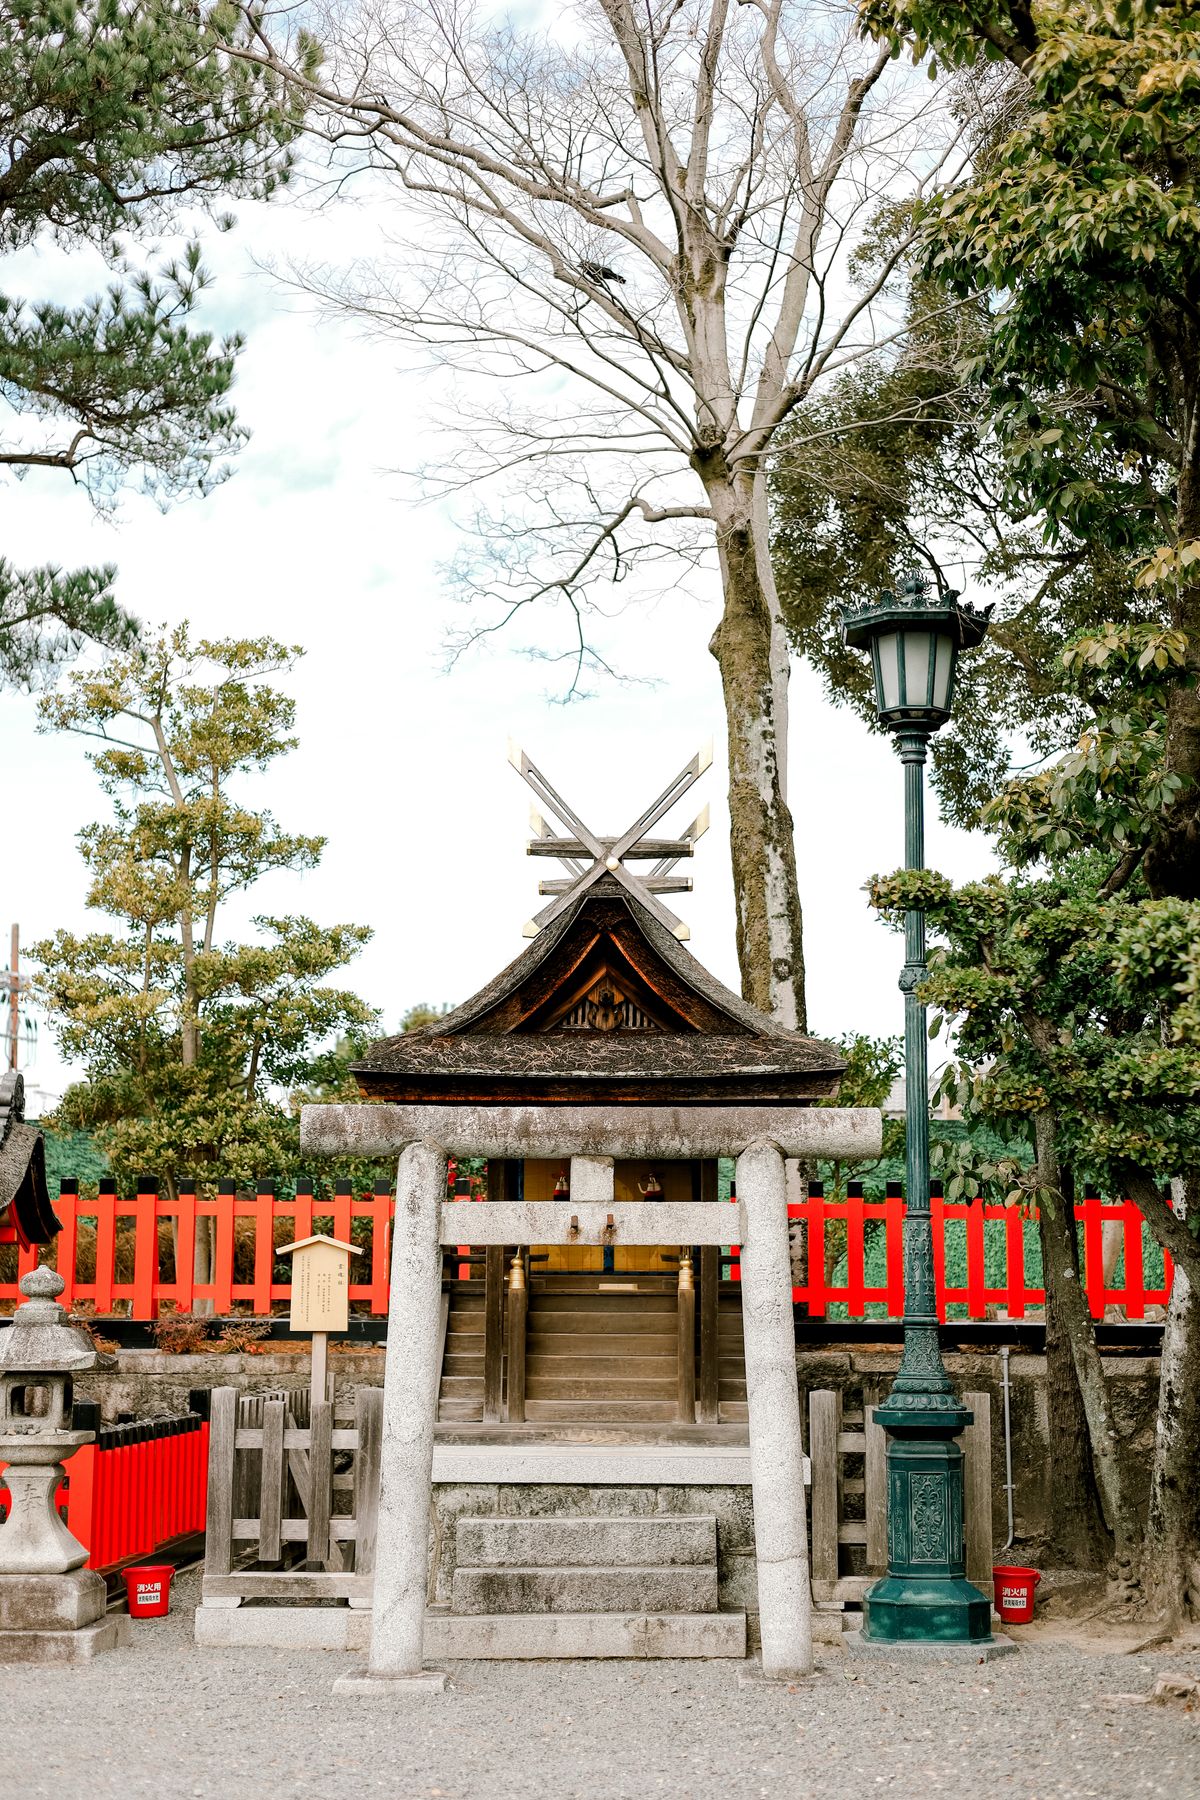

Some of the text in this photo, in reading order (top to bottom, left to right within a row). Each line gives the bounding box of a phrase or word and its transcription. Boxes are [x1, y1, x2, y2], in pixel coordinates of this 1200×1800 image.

[137, 1582, 161, 1592] 消火用
[1002, 1587, 1027, 1596] 消火用
